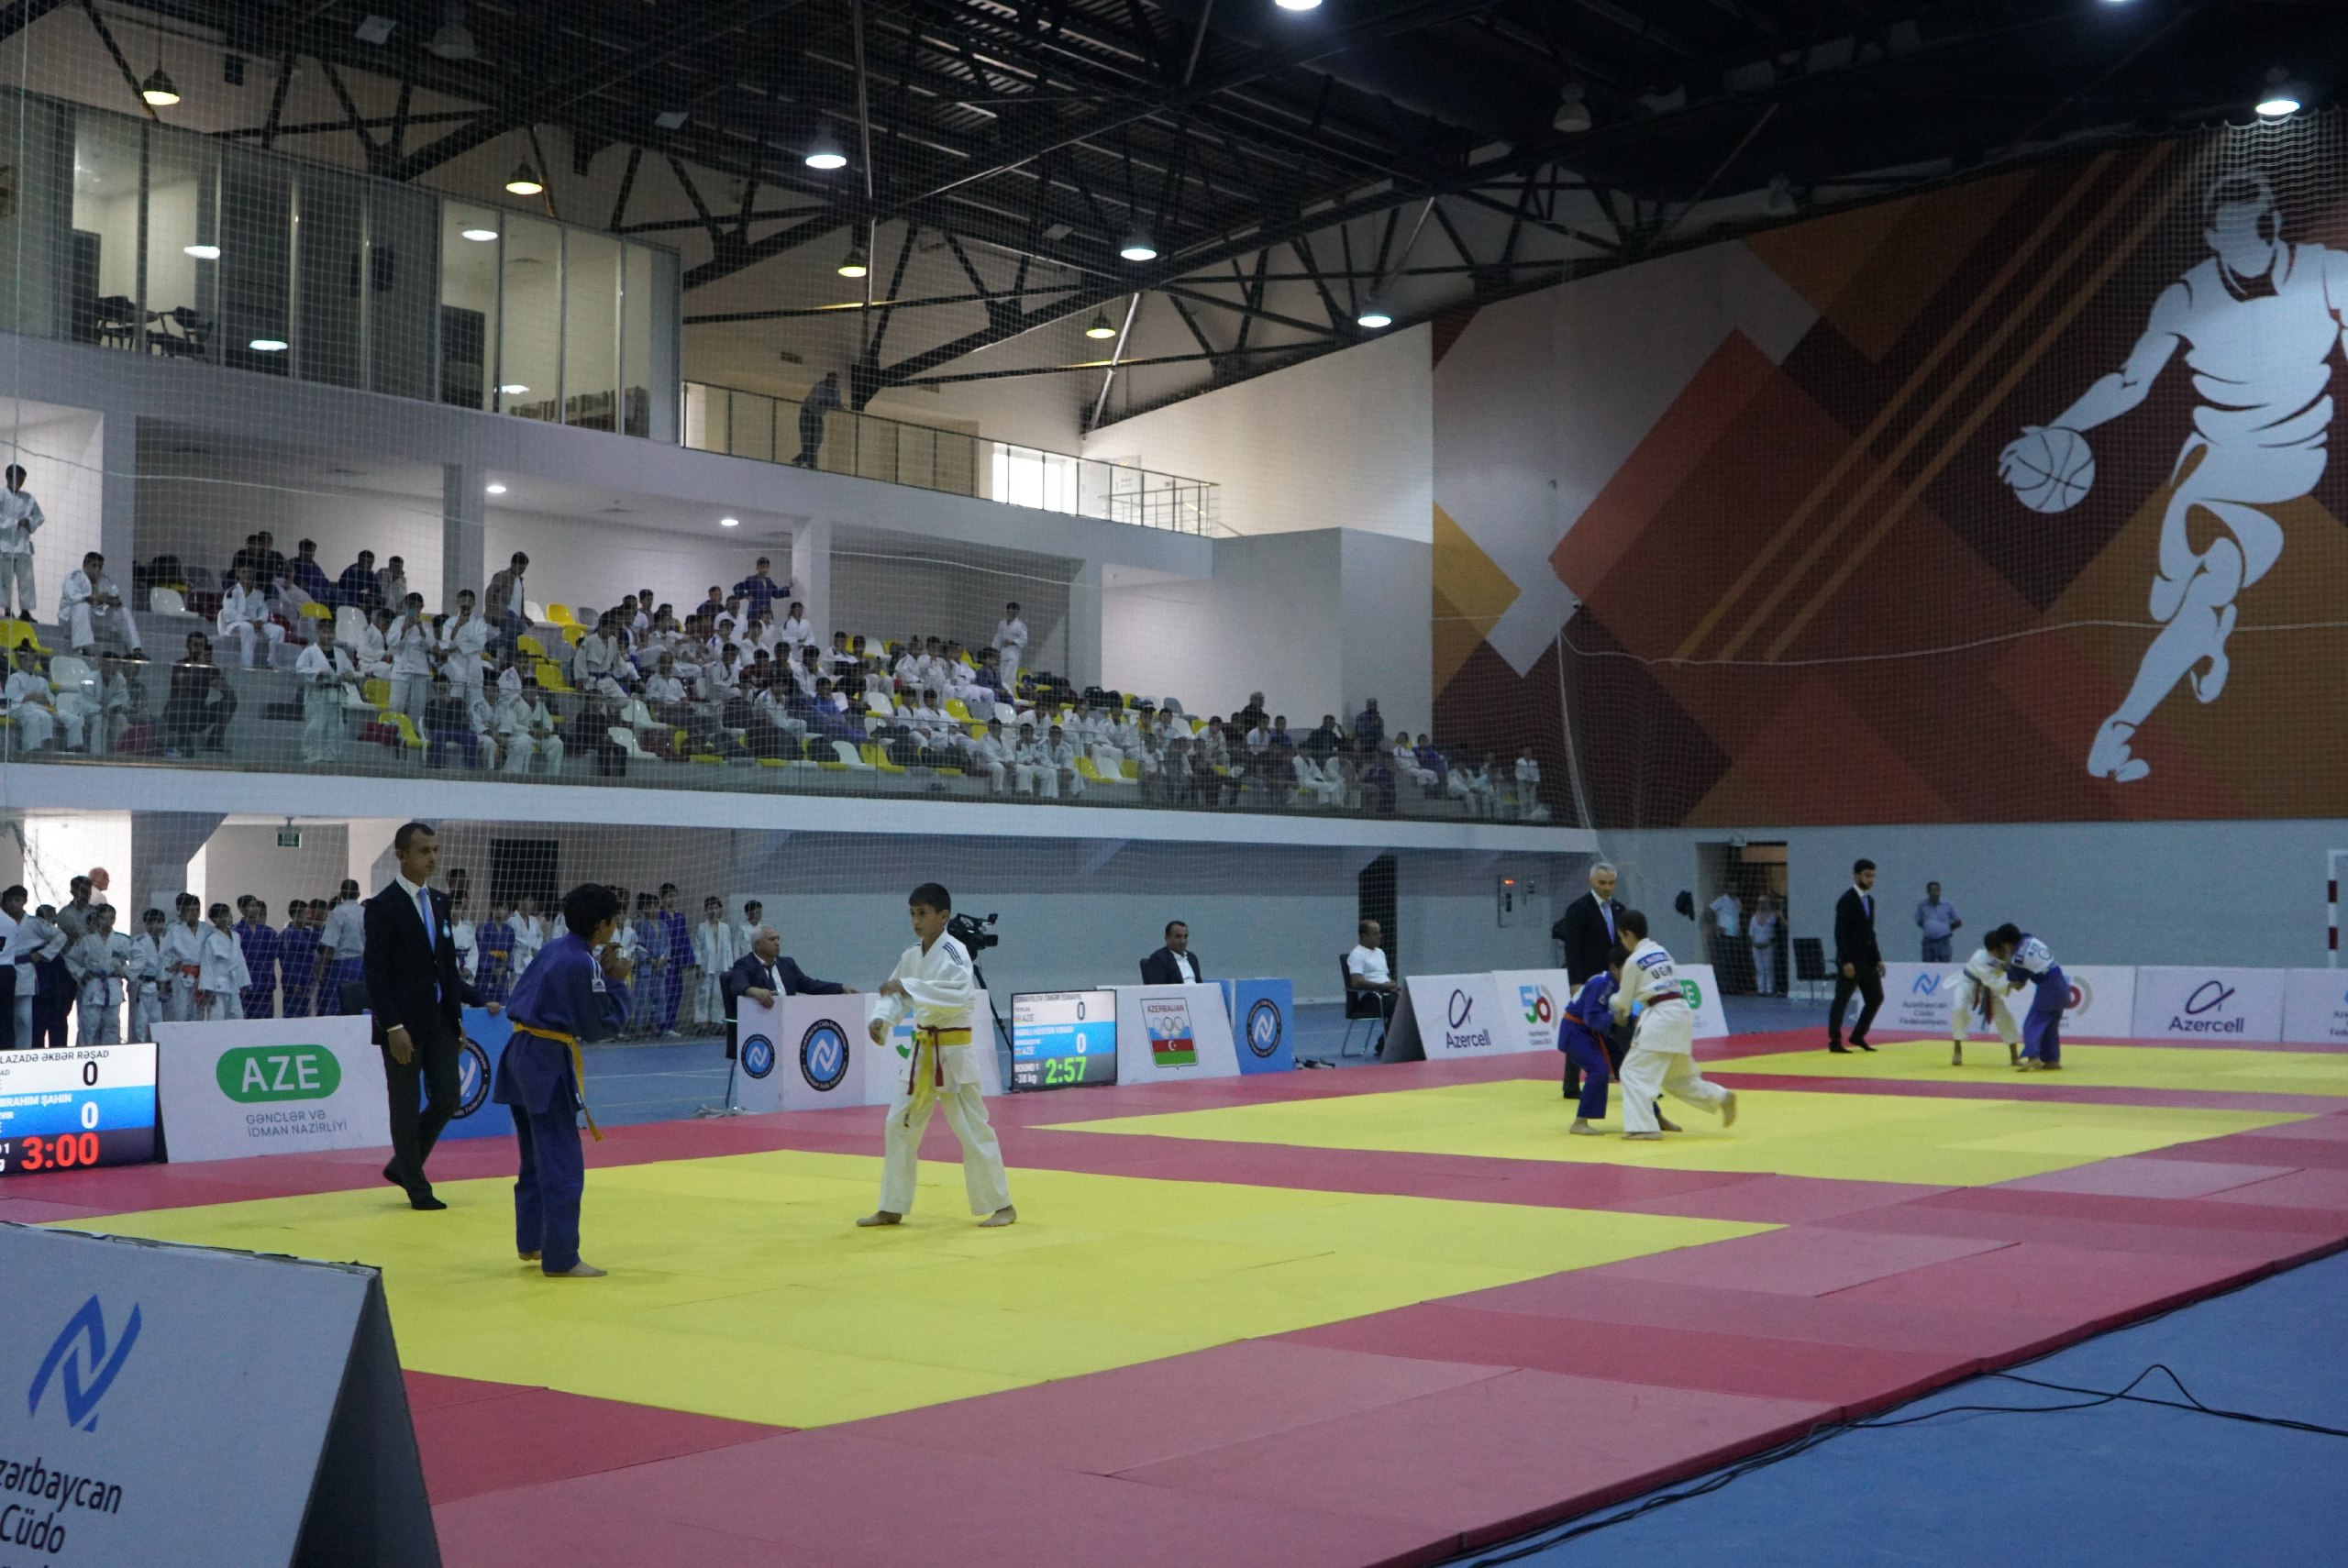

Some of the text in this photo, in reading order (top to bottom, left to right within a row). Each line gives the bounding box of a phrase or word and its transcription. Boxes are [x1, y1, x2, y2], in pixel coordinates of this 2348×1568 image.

[1077, 1001, 1085, 1021] 0
[2168, 1015, 2244, 1032] Azercell
[1076, 1032, 1086, 1054] 0
[1446, 1029, 1491, 1048] Azercell
[41, 1052, 74, 1062] ƏKBƏR
[83, 1061, 98, 1086] 0
[241, 1055, 321, 1093] AZE
[1027, 1072, 1037, 1085] kg
[1045, 1055, 1087, 1084] 2:57
[81, 1101, 99, 1129] 0
[246, 1110, 327, 1125] GƏNCLƏR VƏ
[248, 1118, 349, 1137] İDMAN NAZİRLİYİ
[20, 1132, 100, 1170] 3:00
[0, 1503, 65, 1554] Cüdo
